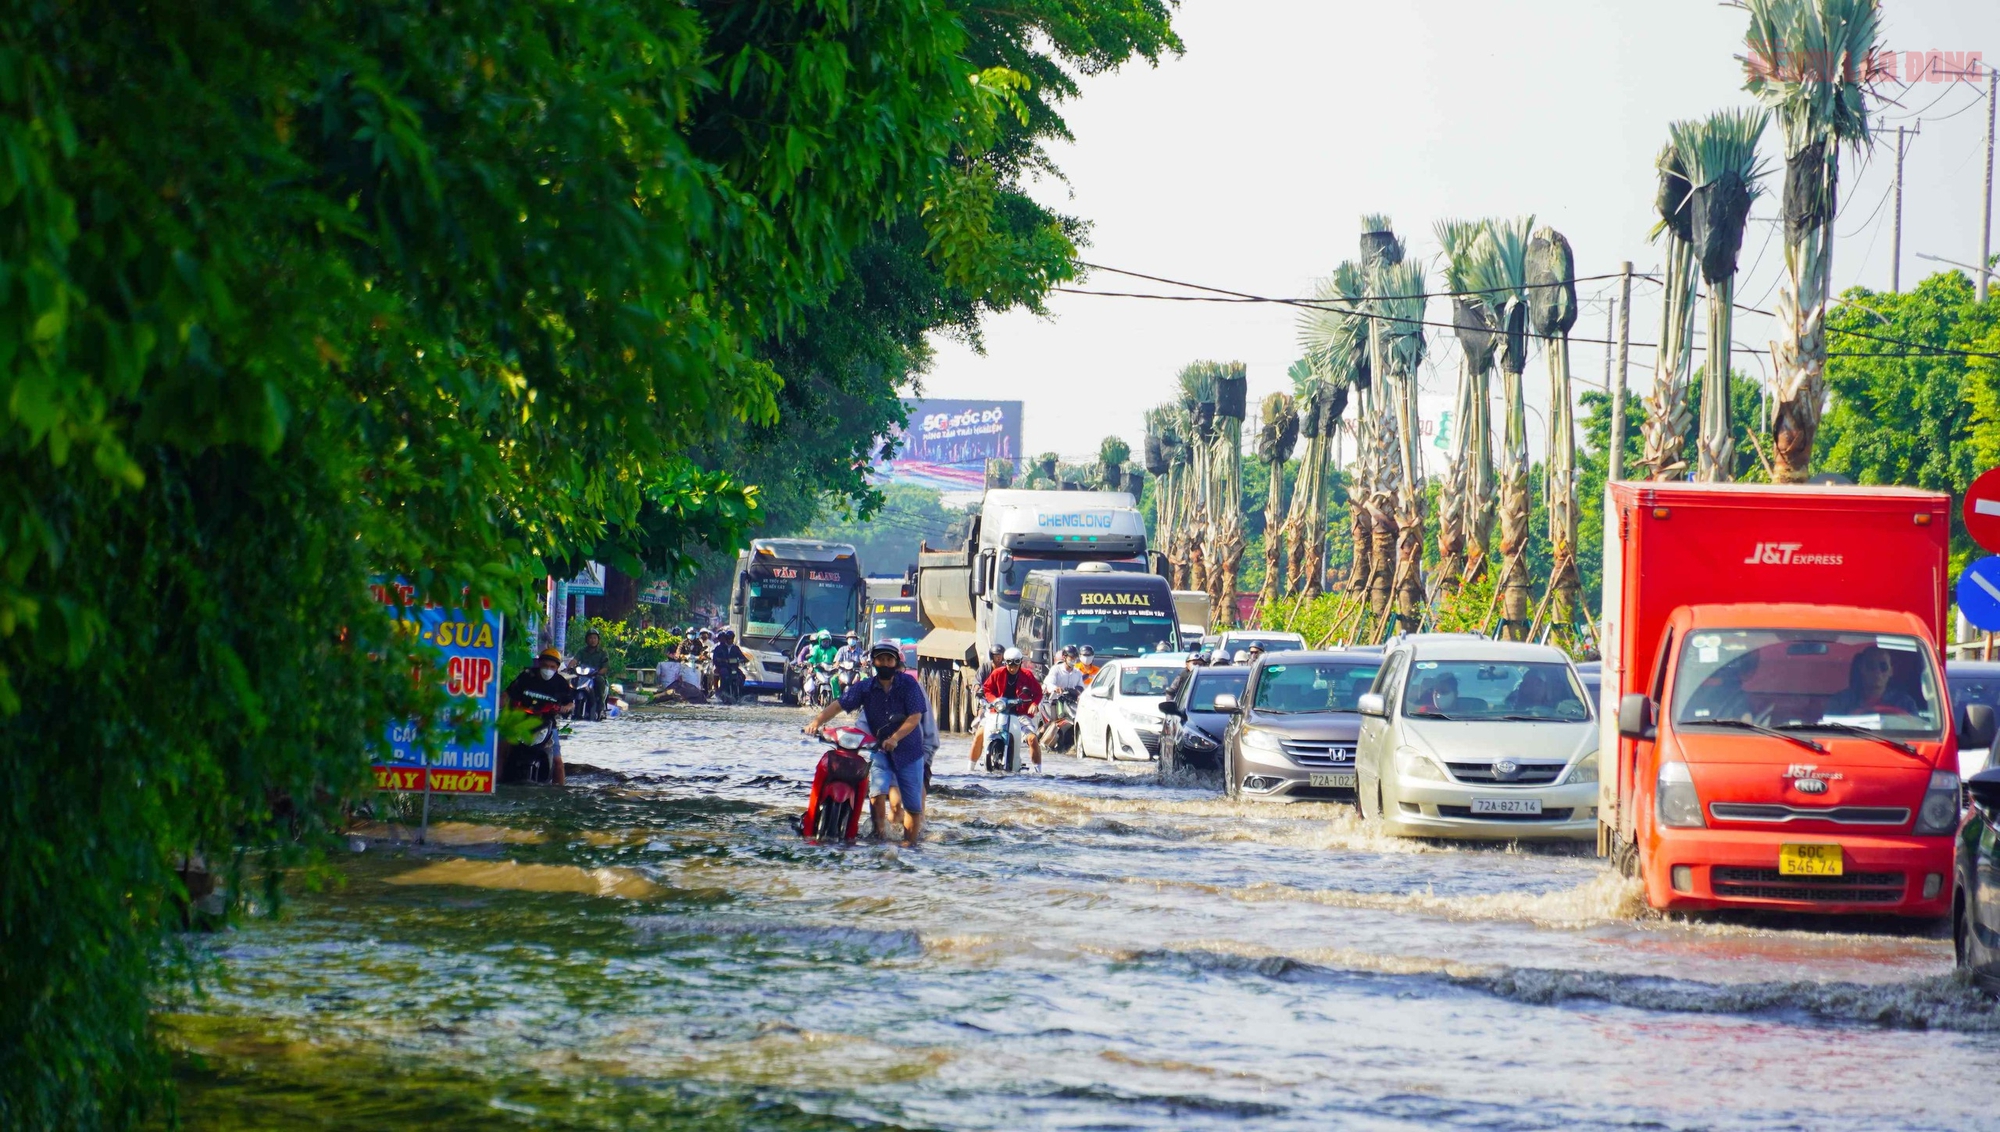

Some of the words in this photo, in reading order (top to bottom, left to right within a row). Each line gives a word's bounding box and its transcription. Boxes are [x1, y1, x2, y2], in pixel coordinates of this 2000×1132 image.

[981, 406, 1003, 423] ĐỘ
[1038, 513, 1112, 528] CHENGLONG
[1744, 542, 1803, 565] J&T
[1792, 554, 1843, 565] EXPRESS
[773, 567, 797, 578] VĂN
[809, 571, 840, 581] LANG
[1081, 593, 1115, 605] HOA
[1116, 593, 1150, 606] MAI
[447, 655, 494, 698] CUP
[462, 752, 490, 768] HƠI
[1782, 763, 1818, 778] J&T
[375, 772, 419, 788] HAY
[429, 771, 489, 792] NHỚT
[1478, 801, 1536, 812] 72A-827.14
[1798, 846, 1824, 859] 60C
[1788, 859, 1836, 873] 546.74
